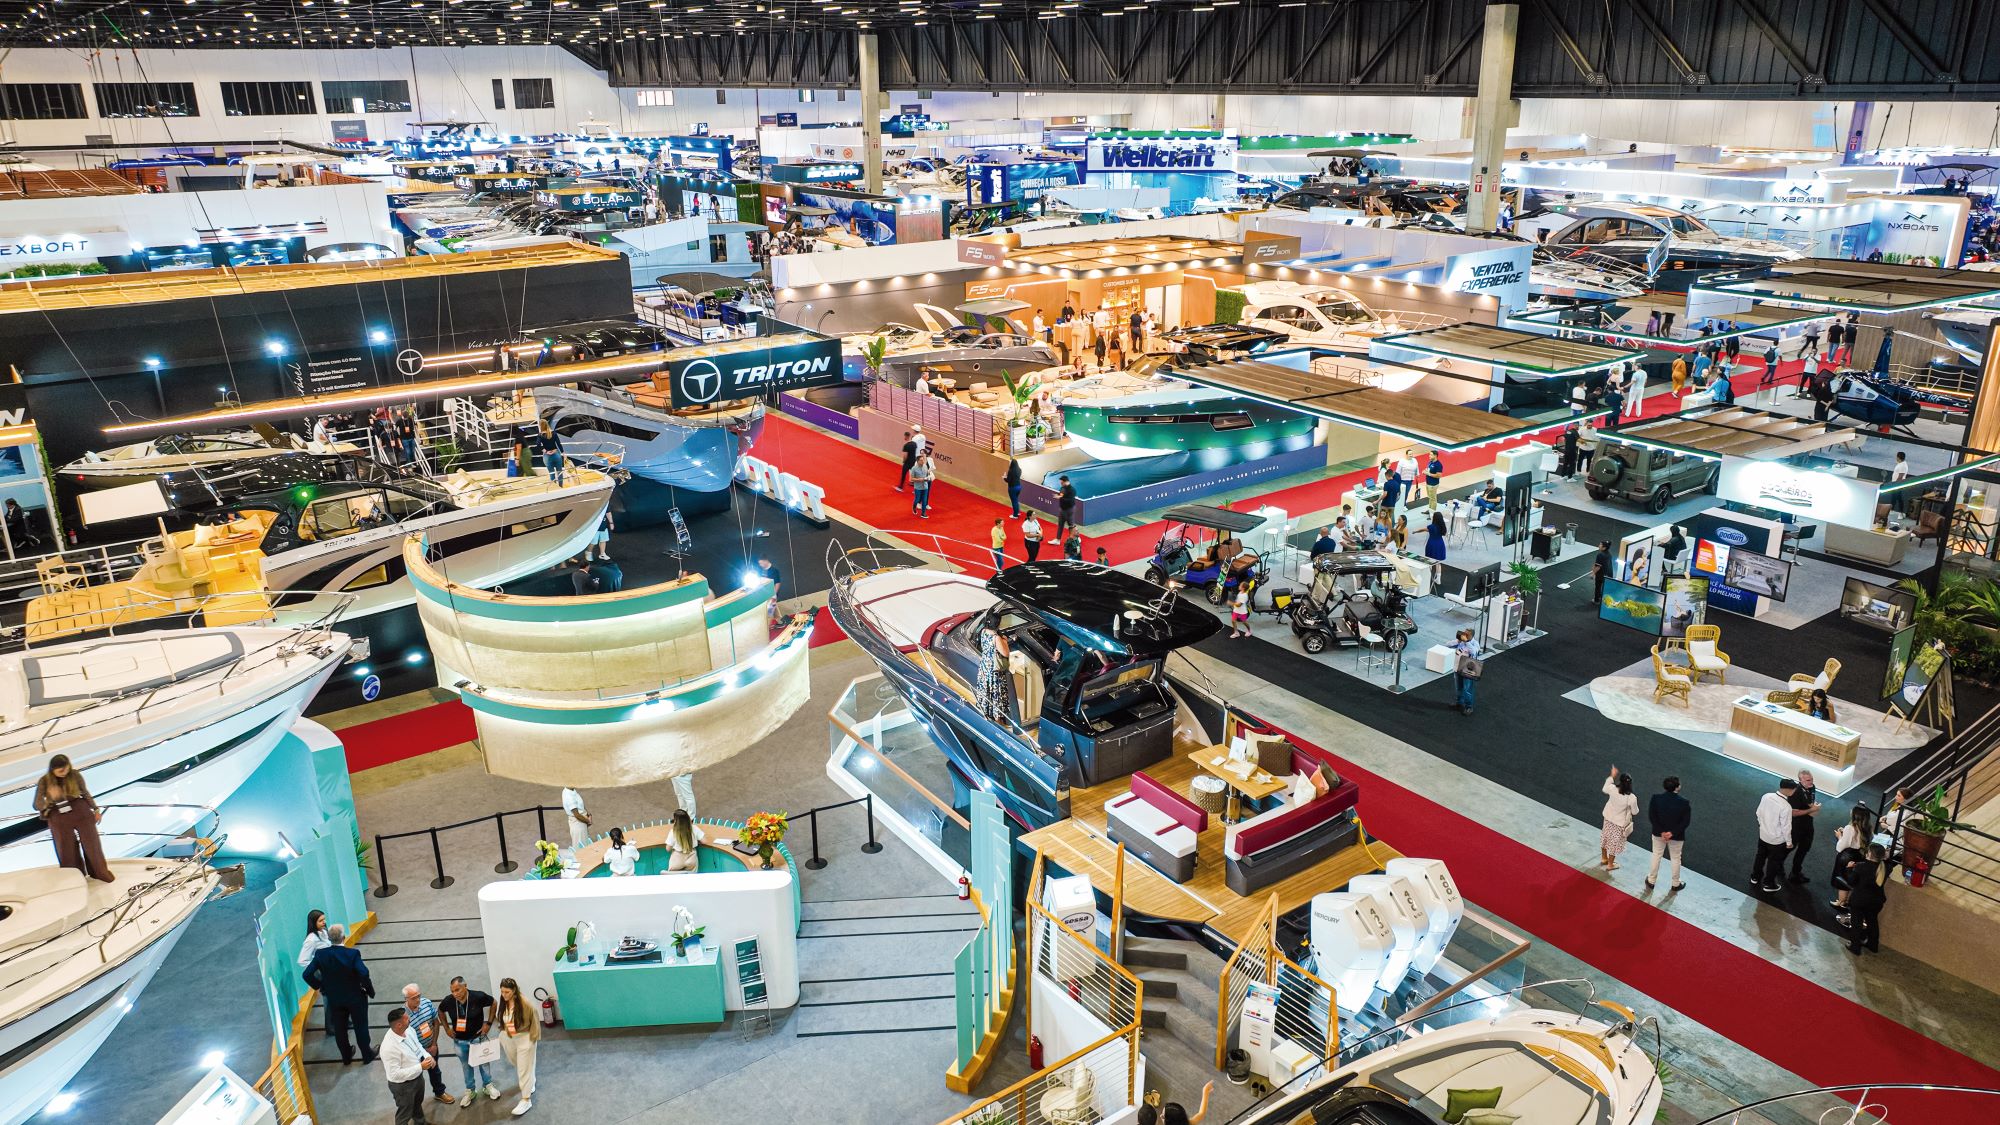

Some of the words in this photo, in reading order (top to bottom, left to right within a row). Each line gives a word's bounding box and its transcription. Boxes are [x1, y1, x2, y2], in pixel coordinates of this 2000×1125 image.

[1103, 144, 1216, 168] Wellcraft
[426, 165, 467, 176] SOLARA
[494, 180, 540, 188] SOLARA
[583, 195, 633, 204] SOLARA
[1773, 196, 1825, 204] NXBOATS
[1887, 222, 1940, 232] NXBOATS
[965, 246, 984, 259] FS
[1254, 245, 1278, 258] FS
[1461, 272, 1524, 291] EXPERIENCE
[968, 284, 990, 296] FS
[733, 356, 831, 385] TRITON
[765, 377, 806, 388] YACHTS
[934, 451, 953, 464] YACHTS
[1719, 531, 1744, 543] podium
[1438, 874, 1453, 895] 400
[1064, 915, 1089, 925] sessa
[1314, 911, 1341, 924] MERCURY
